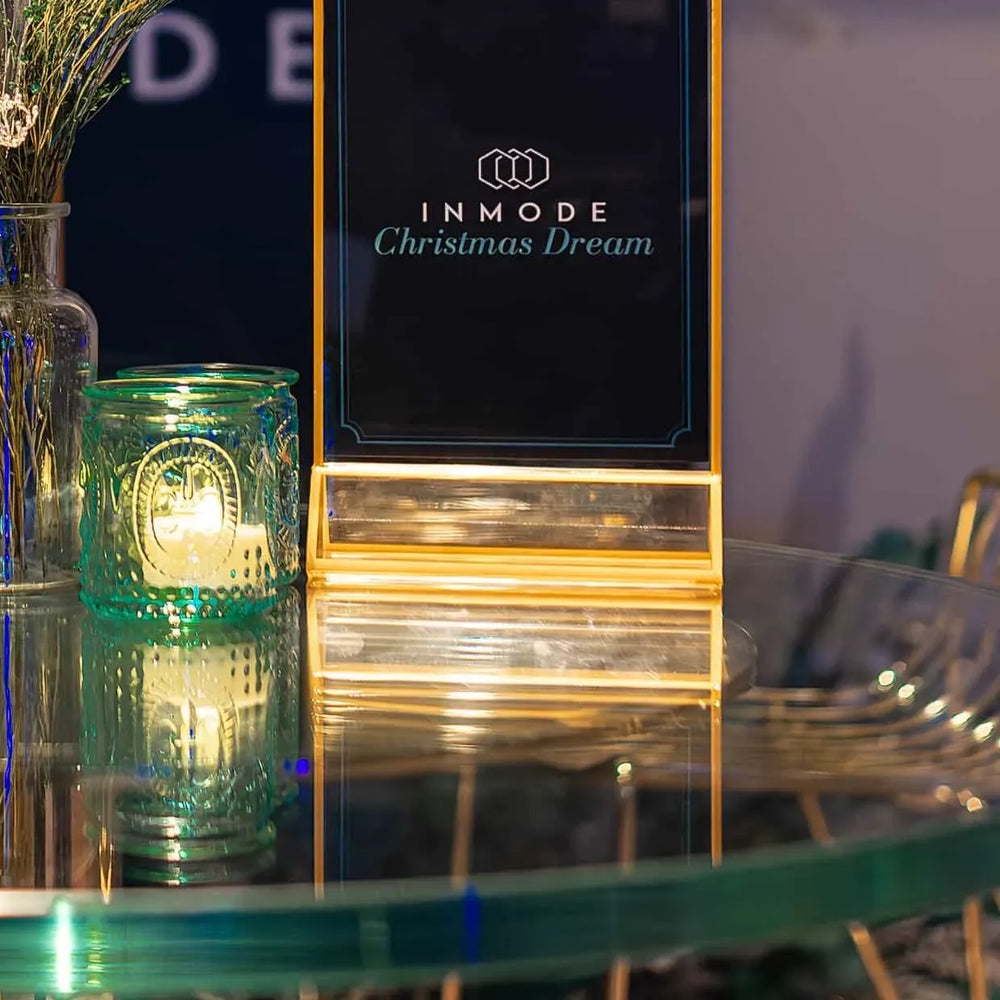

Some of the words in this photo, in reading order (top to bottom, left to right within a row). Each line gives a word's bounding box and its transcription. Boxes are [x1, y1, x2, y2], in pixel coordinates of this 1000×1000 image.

[422, 202, 607, 223] INMODE
[374, 226, 533, 256] Christmas
[542, 226, 655, 256] Dream
